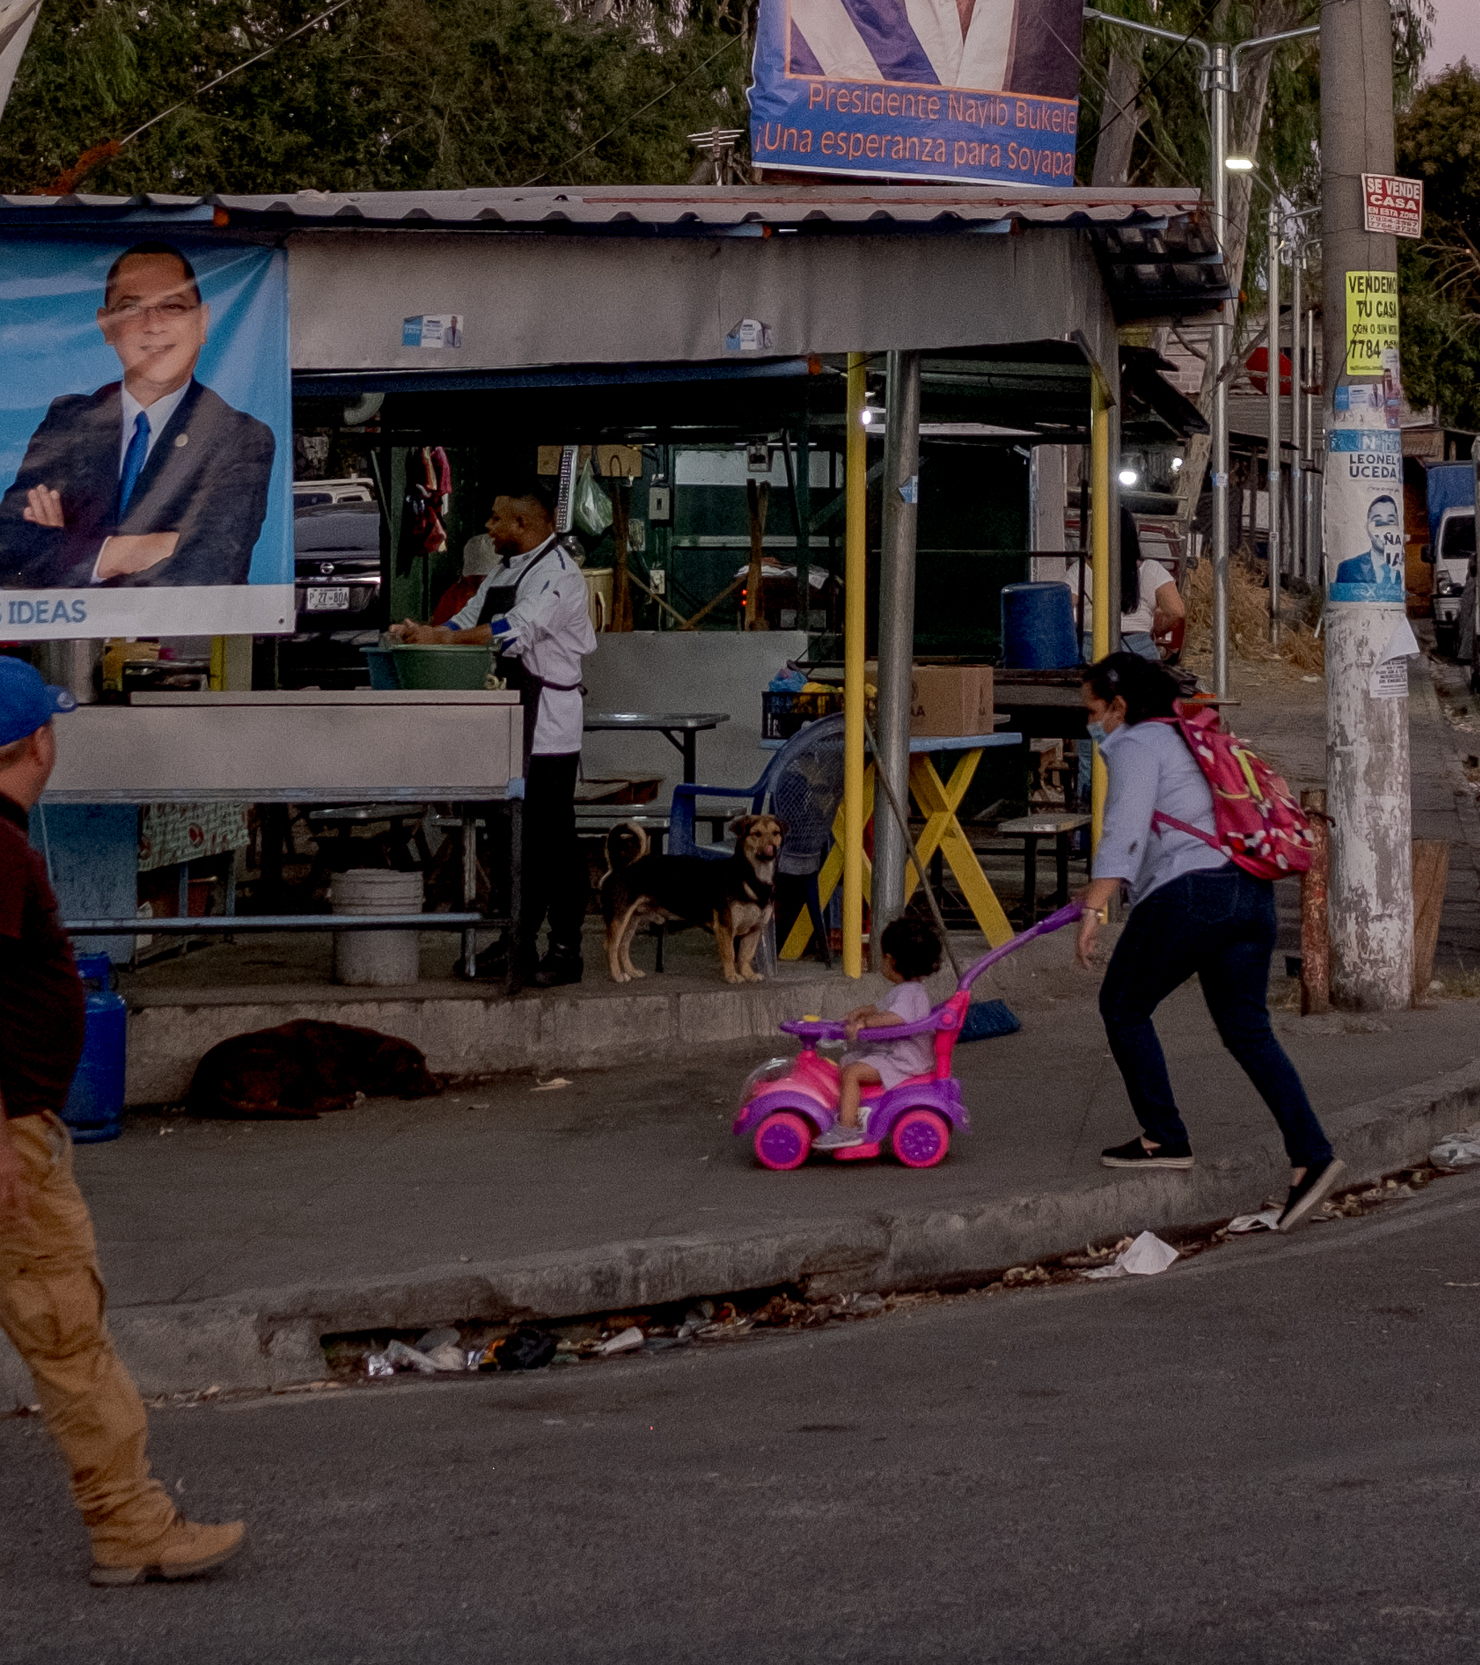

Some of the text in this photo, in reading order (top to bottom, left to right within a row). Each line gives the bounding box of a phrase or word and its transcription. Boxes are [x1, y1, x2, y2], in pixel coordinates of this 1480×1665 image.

[808, 82, 1077, 135] Presidente Nayib Bukele
[754, 122, 813, 154] ¡Una
[820, 132, 946, 163] esperanza
[953, 139, 1001, 169] para
[1367, 177, 1422, 201] SE VENDE
[1369, 194, 1418, 212] CASA
[1349, 276, 1398, 294] VENDEMO
[1356, 300, 1373, 318] TU
[1351, 339, 1382, 360] 7784
[1349, 453, 1397, 466] LEONEL
[1349, 466, 1398, 479] UCEDA
[8, 599, 88, 625] IDEAS
